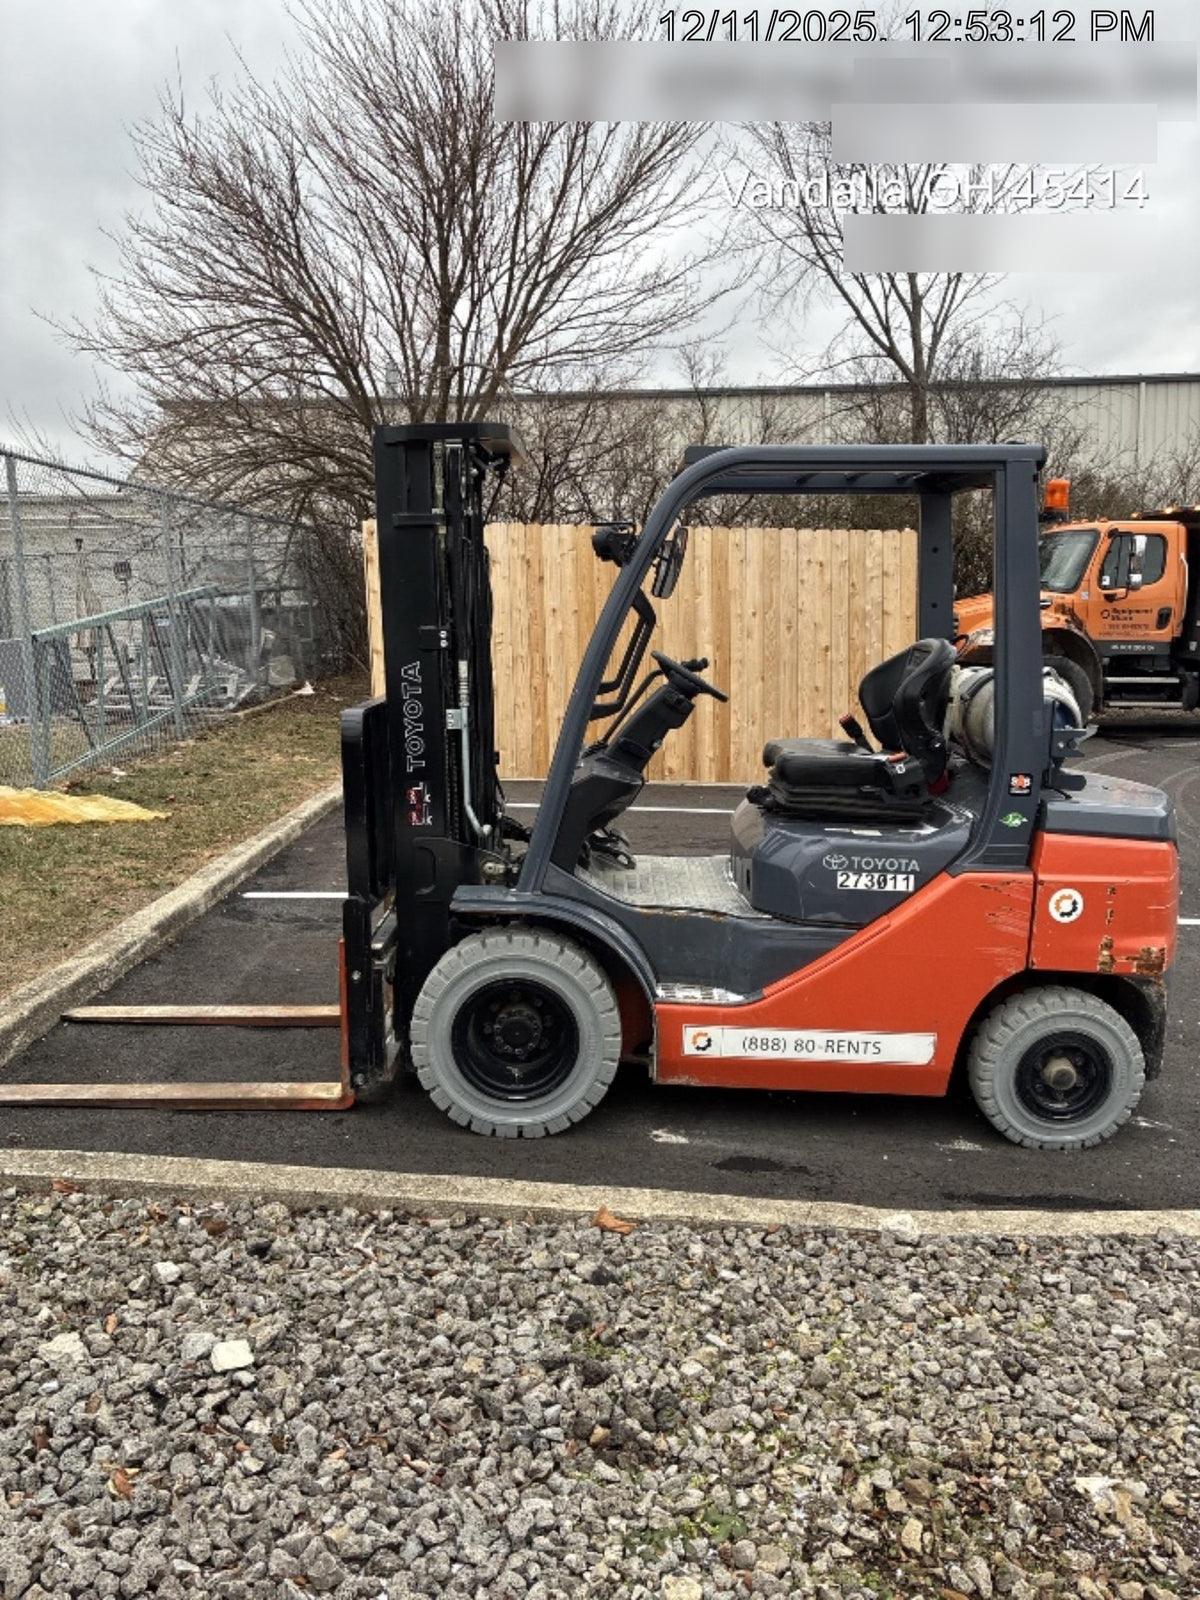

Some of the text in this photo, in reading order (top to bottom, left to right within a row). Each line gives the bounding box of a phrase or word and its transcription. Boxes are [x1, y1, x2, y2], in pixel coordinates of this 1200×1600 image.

[401, 661, 426, 773] TOYOTA
[851, 856, 920, 872] TOYOTA
[839, 872, 911, 890] 273011
[742, 1037, 882, 1055] (888) 80-RENTS
